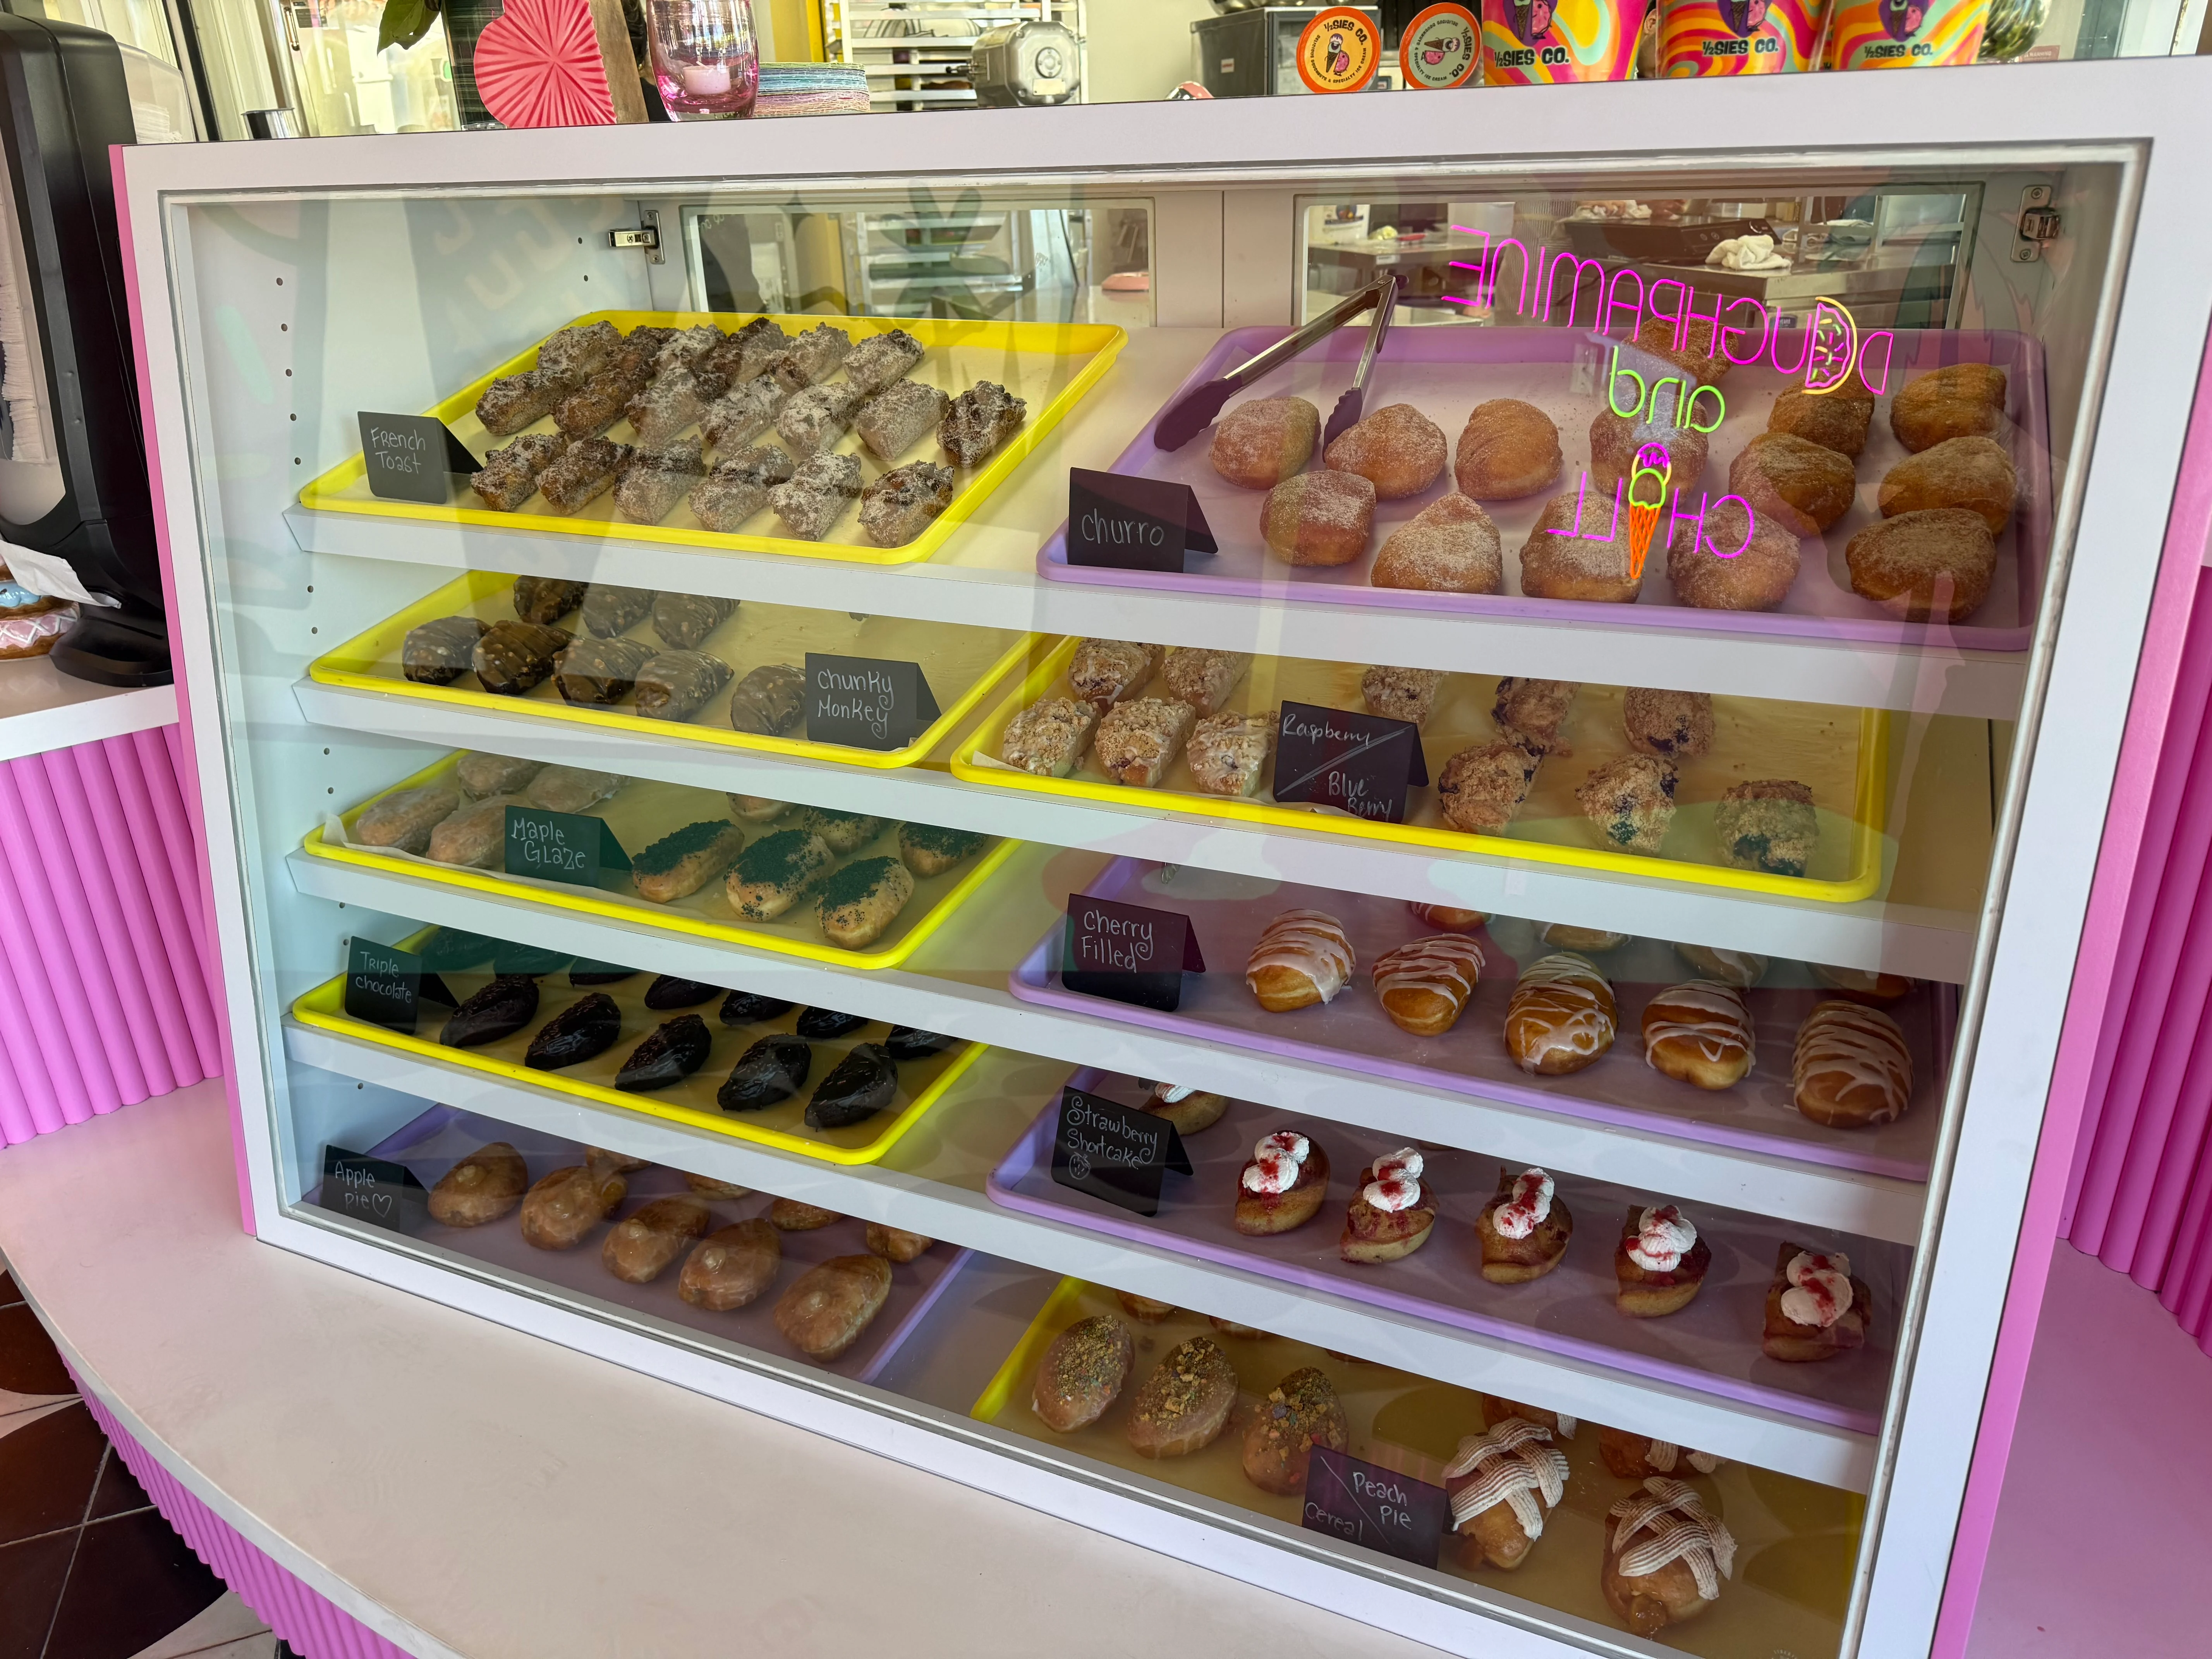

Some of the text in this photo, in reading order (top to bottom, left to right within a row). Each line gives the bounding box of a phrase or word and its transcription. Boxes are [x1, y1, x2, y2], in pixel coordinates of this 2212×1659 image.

[1355, 28, 1367, 45] CO.
[1755, 38, 1778, 53] CO.
[1541, 47, 1569, 64] CO.
[1911, 43, 1933, 57] CO.
[1449, 64, 1464, 77] CO.
[375, 451, 421, 475] Toast
[1328, 771, 1369, 797] Blue
[1347, 797, 1393, 822] Berry
[511, 817, 565, 845] Maple
[1081, 936, 1137, 974] Filled
[1066, 1096, 1158, 1164] Strawberry
[335, 1161, 375, 1188] Apple
[1353, 1472, 1407, 1506] Peach
[1305, 1501, 1363, 1542] Cereal
[1380, 1505, 1412, 1530] Pie
